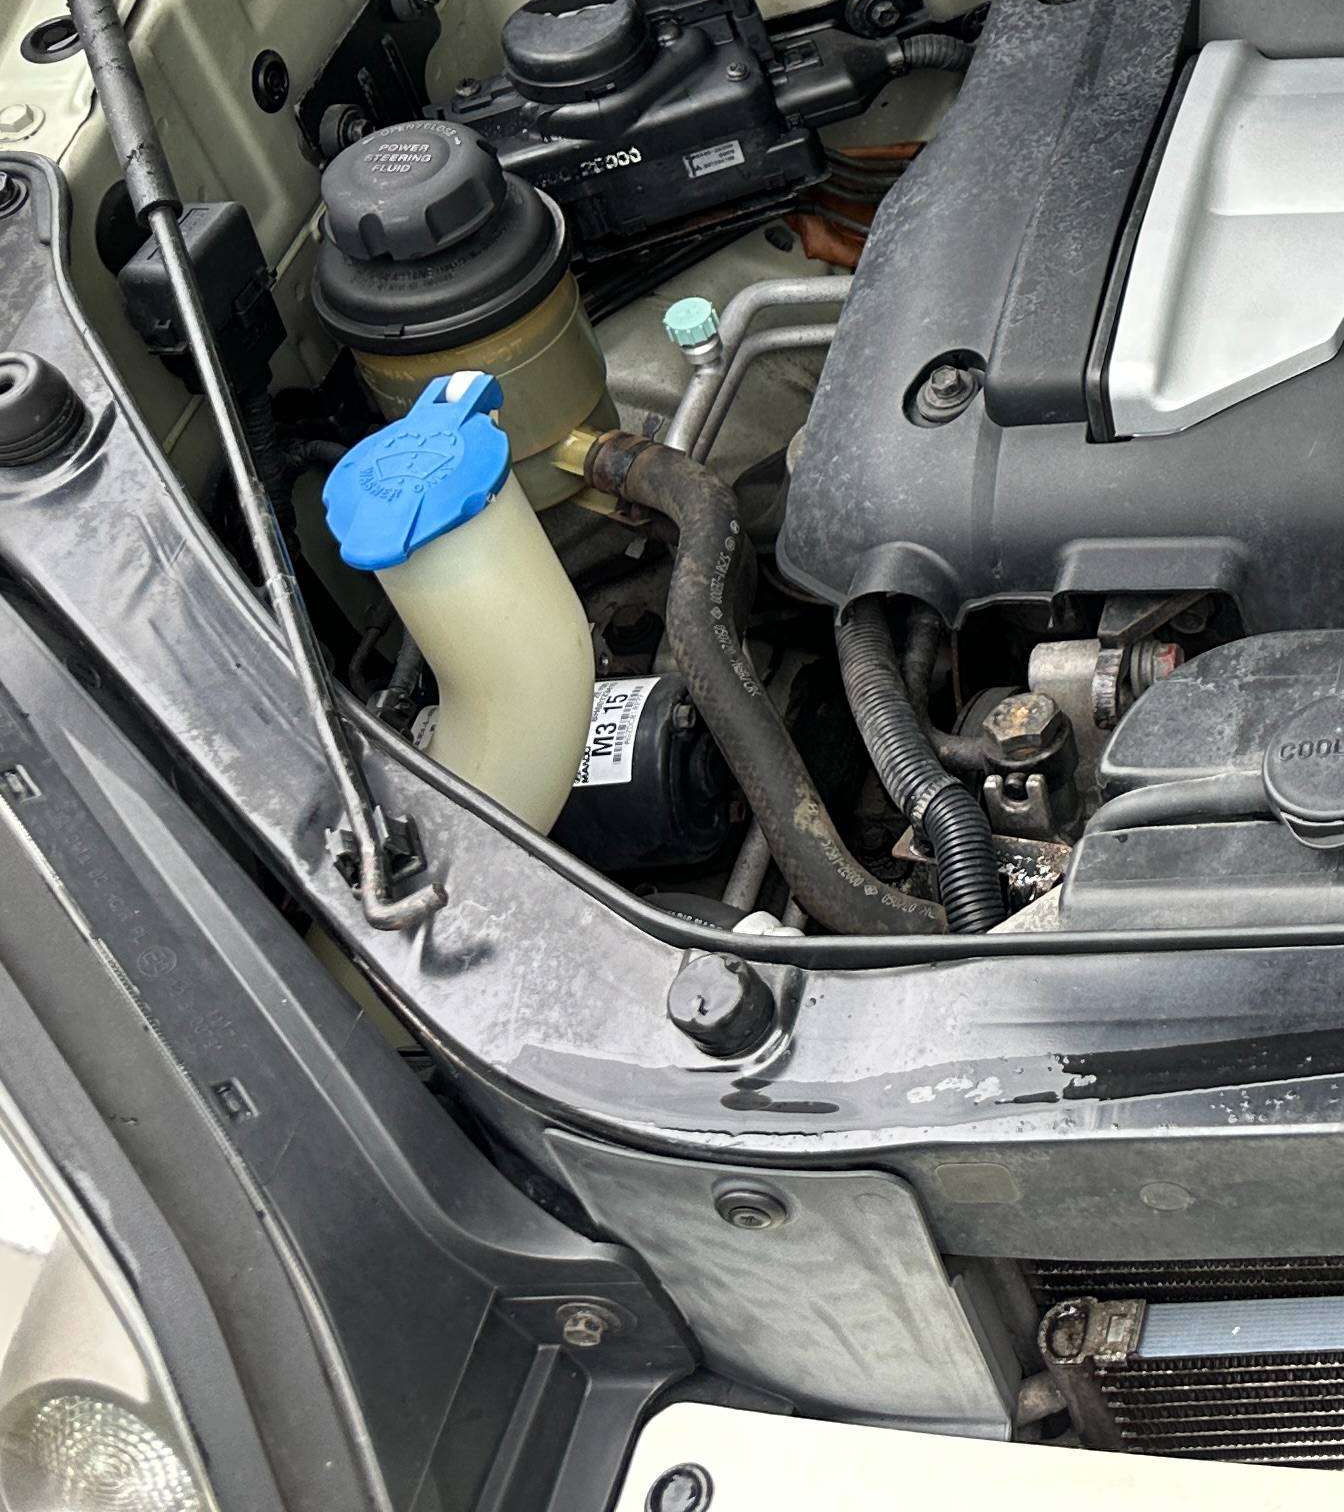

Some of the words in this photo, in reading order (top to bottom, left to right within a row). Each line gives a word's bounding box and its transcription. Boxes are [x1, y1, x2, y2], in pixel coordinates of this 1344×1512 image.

[379, 143, 430, 152] POWER
[363, 153, 432, 163] STEERING
[371, 164, 411, 173] FLUID
[603, 693, 629, 714] 15
[591, 722, 617, 757] M3
